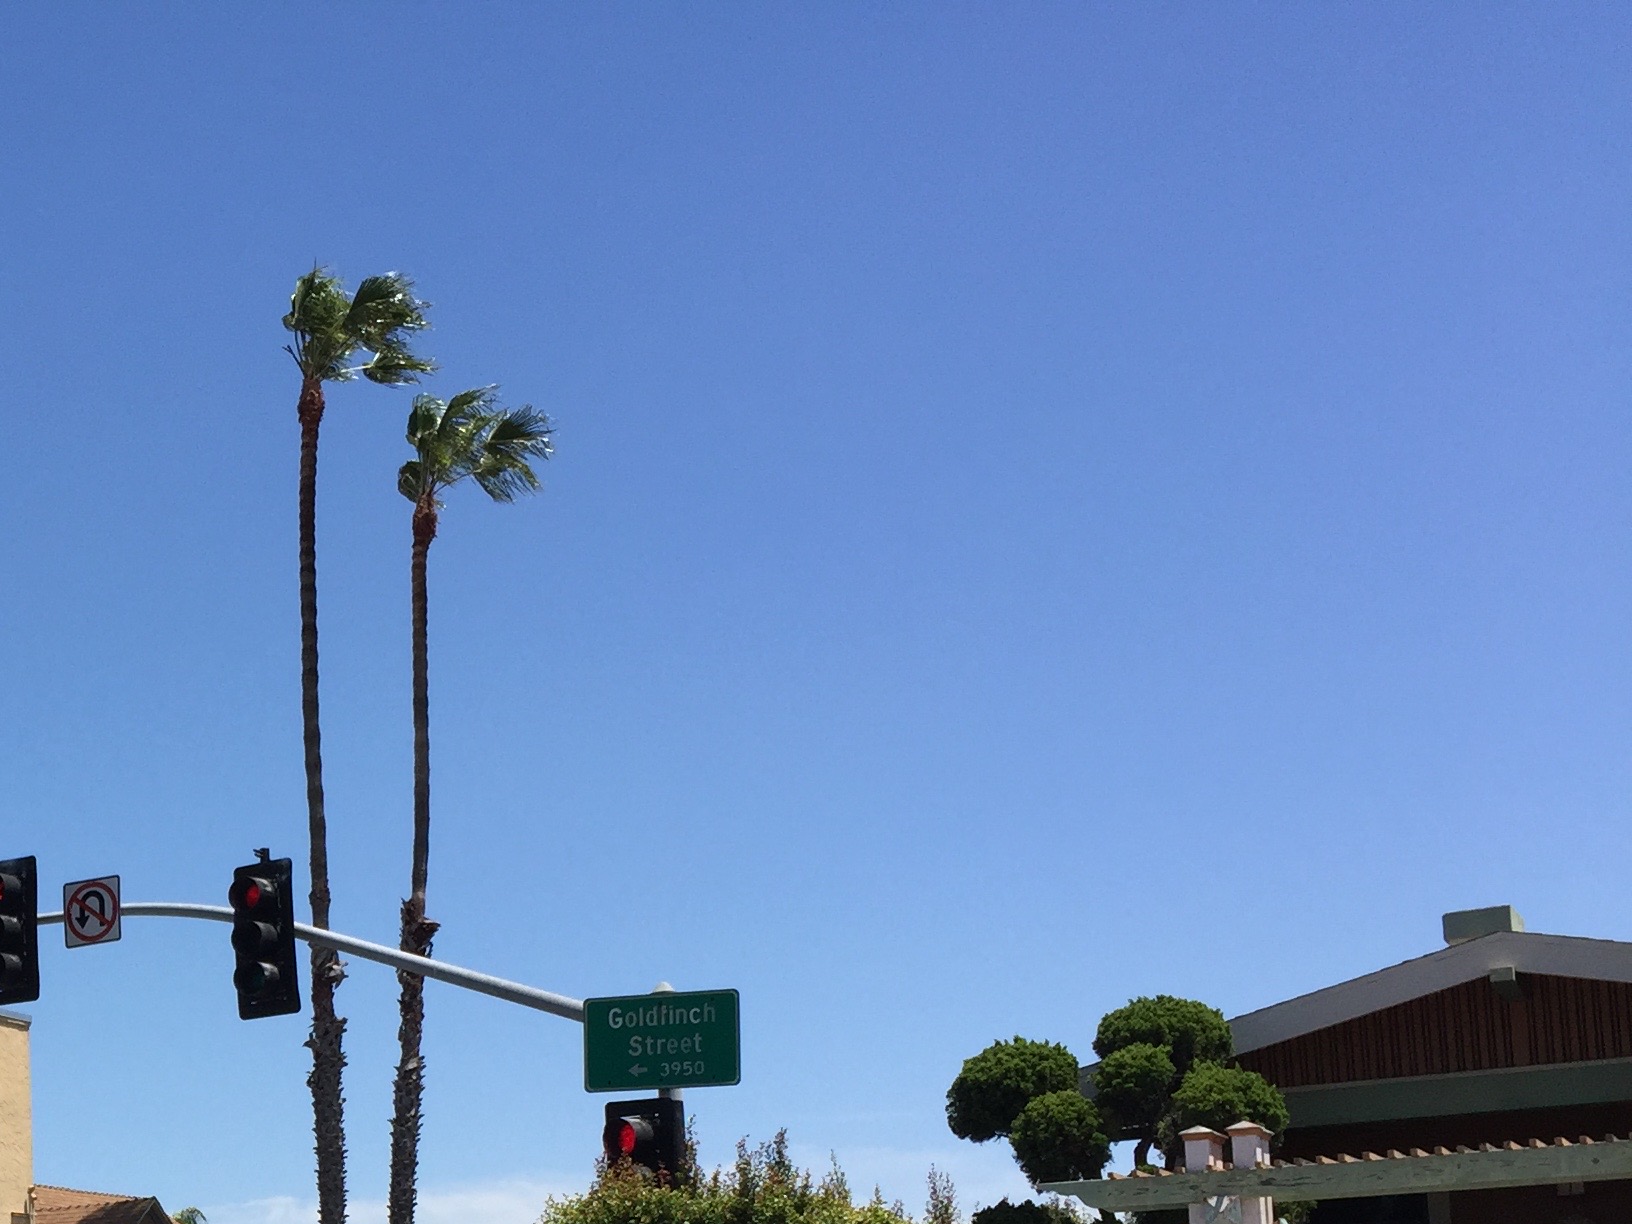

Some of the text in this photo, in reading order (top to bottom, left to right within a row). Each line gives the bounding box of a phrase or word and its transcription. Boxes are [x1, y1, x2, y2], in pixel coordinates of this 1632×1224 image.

[608, 1002, 716, 1029] Goldfinch
[628, 1032, 703, 1057] Street
[660, 1061, 705, 1077] 3950
